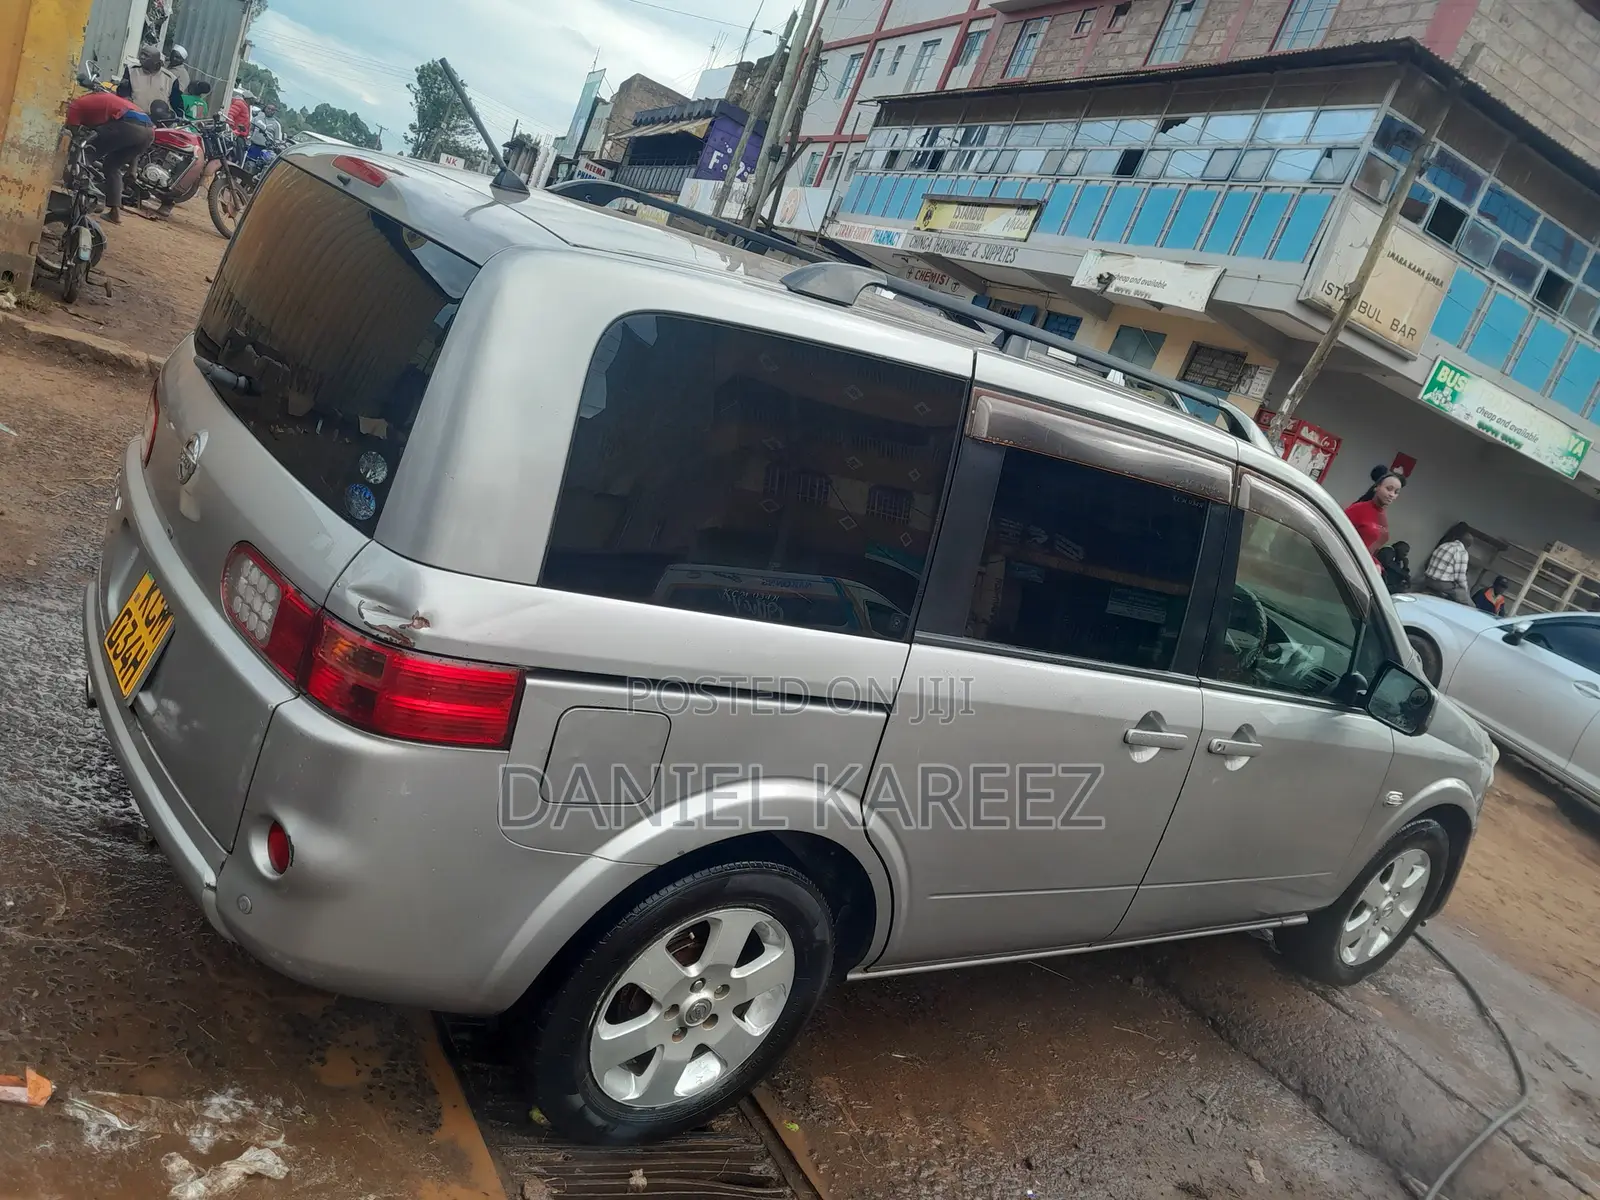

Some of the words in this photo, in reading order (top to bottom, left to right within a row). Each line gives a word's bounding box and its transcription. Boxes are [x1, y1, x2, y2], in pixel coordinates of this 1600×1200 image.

[934, 237, 971, 258] HARDWARE
[980, 243, 1019, 264] SUPPLIES
[914, 271, 950, 286] CHEMIST
[1129, 274, 1142, 285] and
[1140, 276, 1168, 290] available
[1389, 318, 1418, 342] BAR
[1476, 405, 1497, 422] cheap
[1496, 415, 1510, 429] and
[1509, 423, 1540, 444] available
[107, 607, 149, 690] 034H
